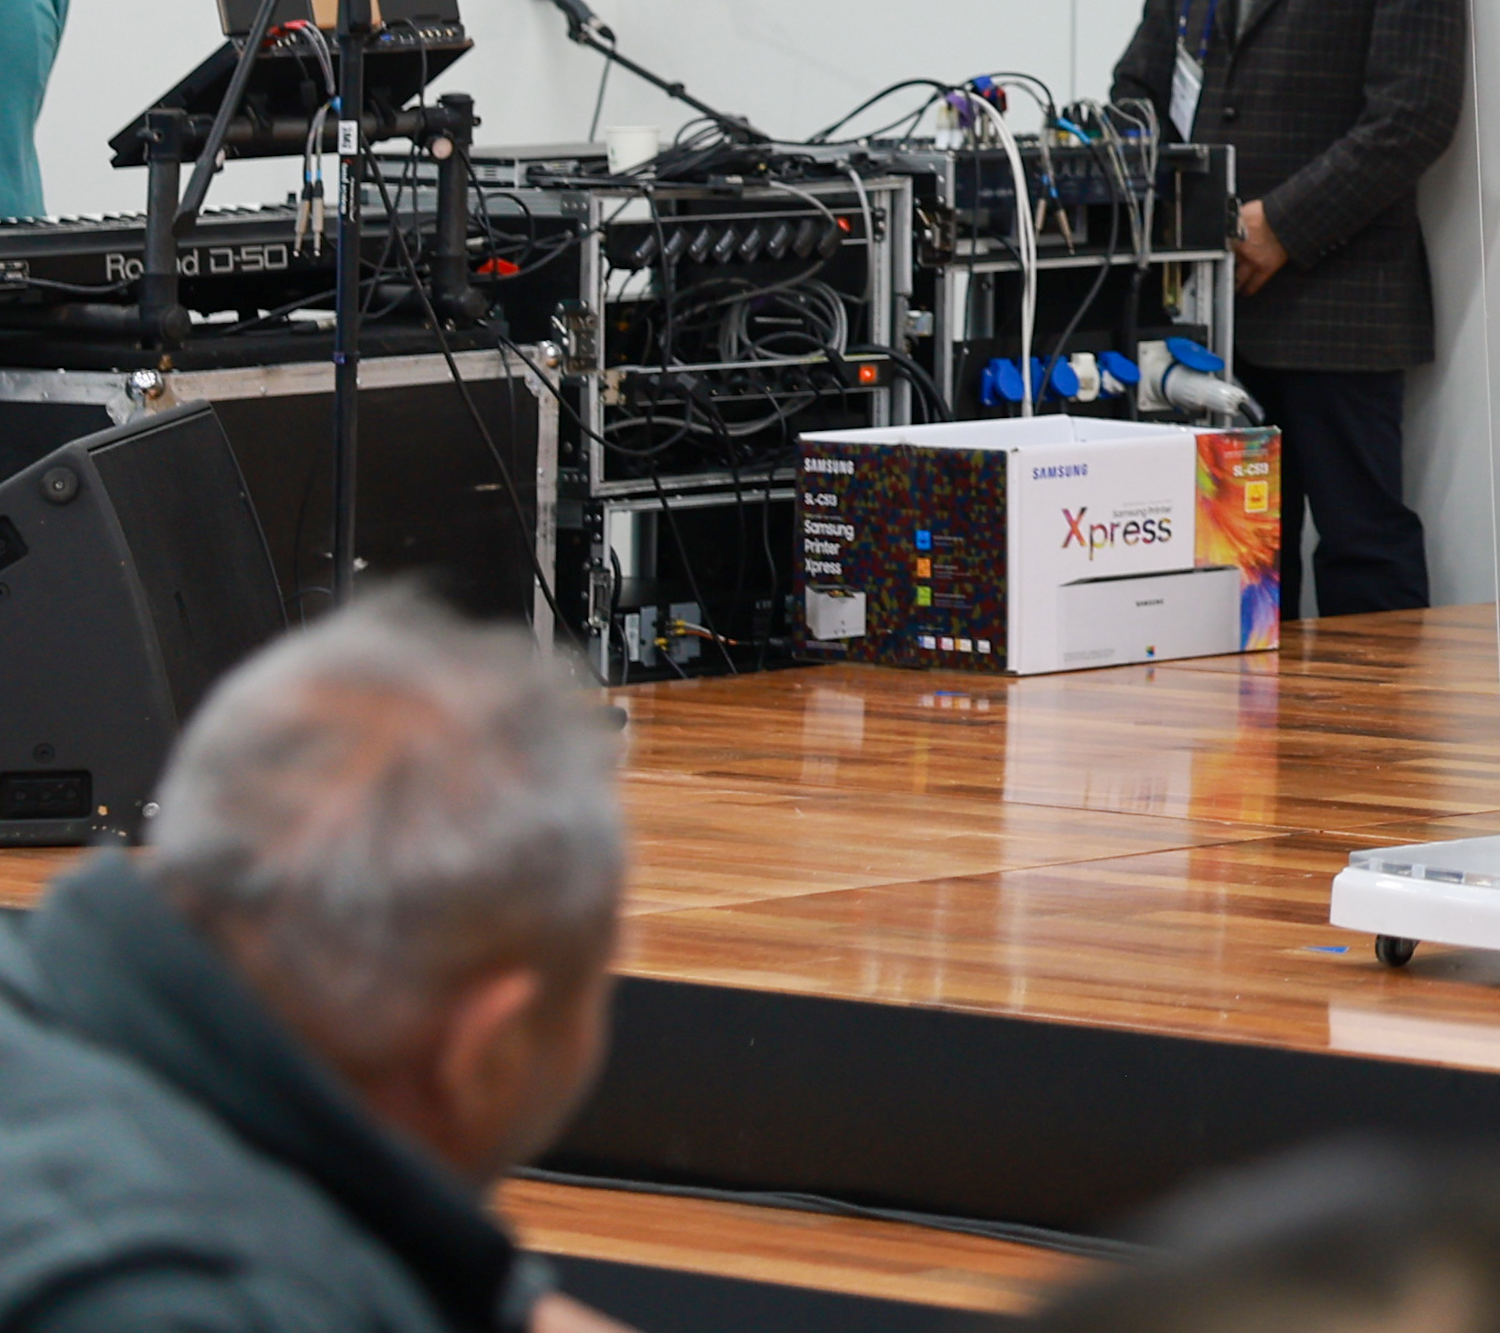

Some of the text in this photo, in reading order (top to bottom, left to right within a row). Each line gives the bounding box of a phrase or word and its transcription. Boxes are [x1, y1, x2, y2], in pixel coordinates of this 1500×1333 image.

[209, 244, 288, 273] D-50
[804, 457, 855, 475] SAMSUNG
[1032, 463, 1088, 480] SAMSUNG
[804, 519, 855, 542] Samsung
[1060, 505, 1173, 562] Xpress
[804, 538, 841, 556] Printer
[804, 557, 843, 577] Xpress
